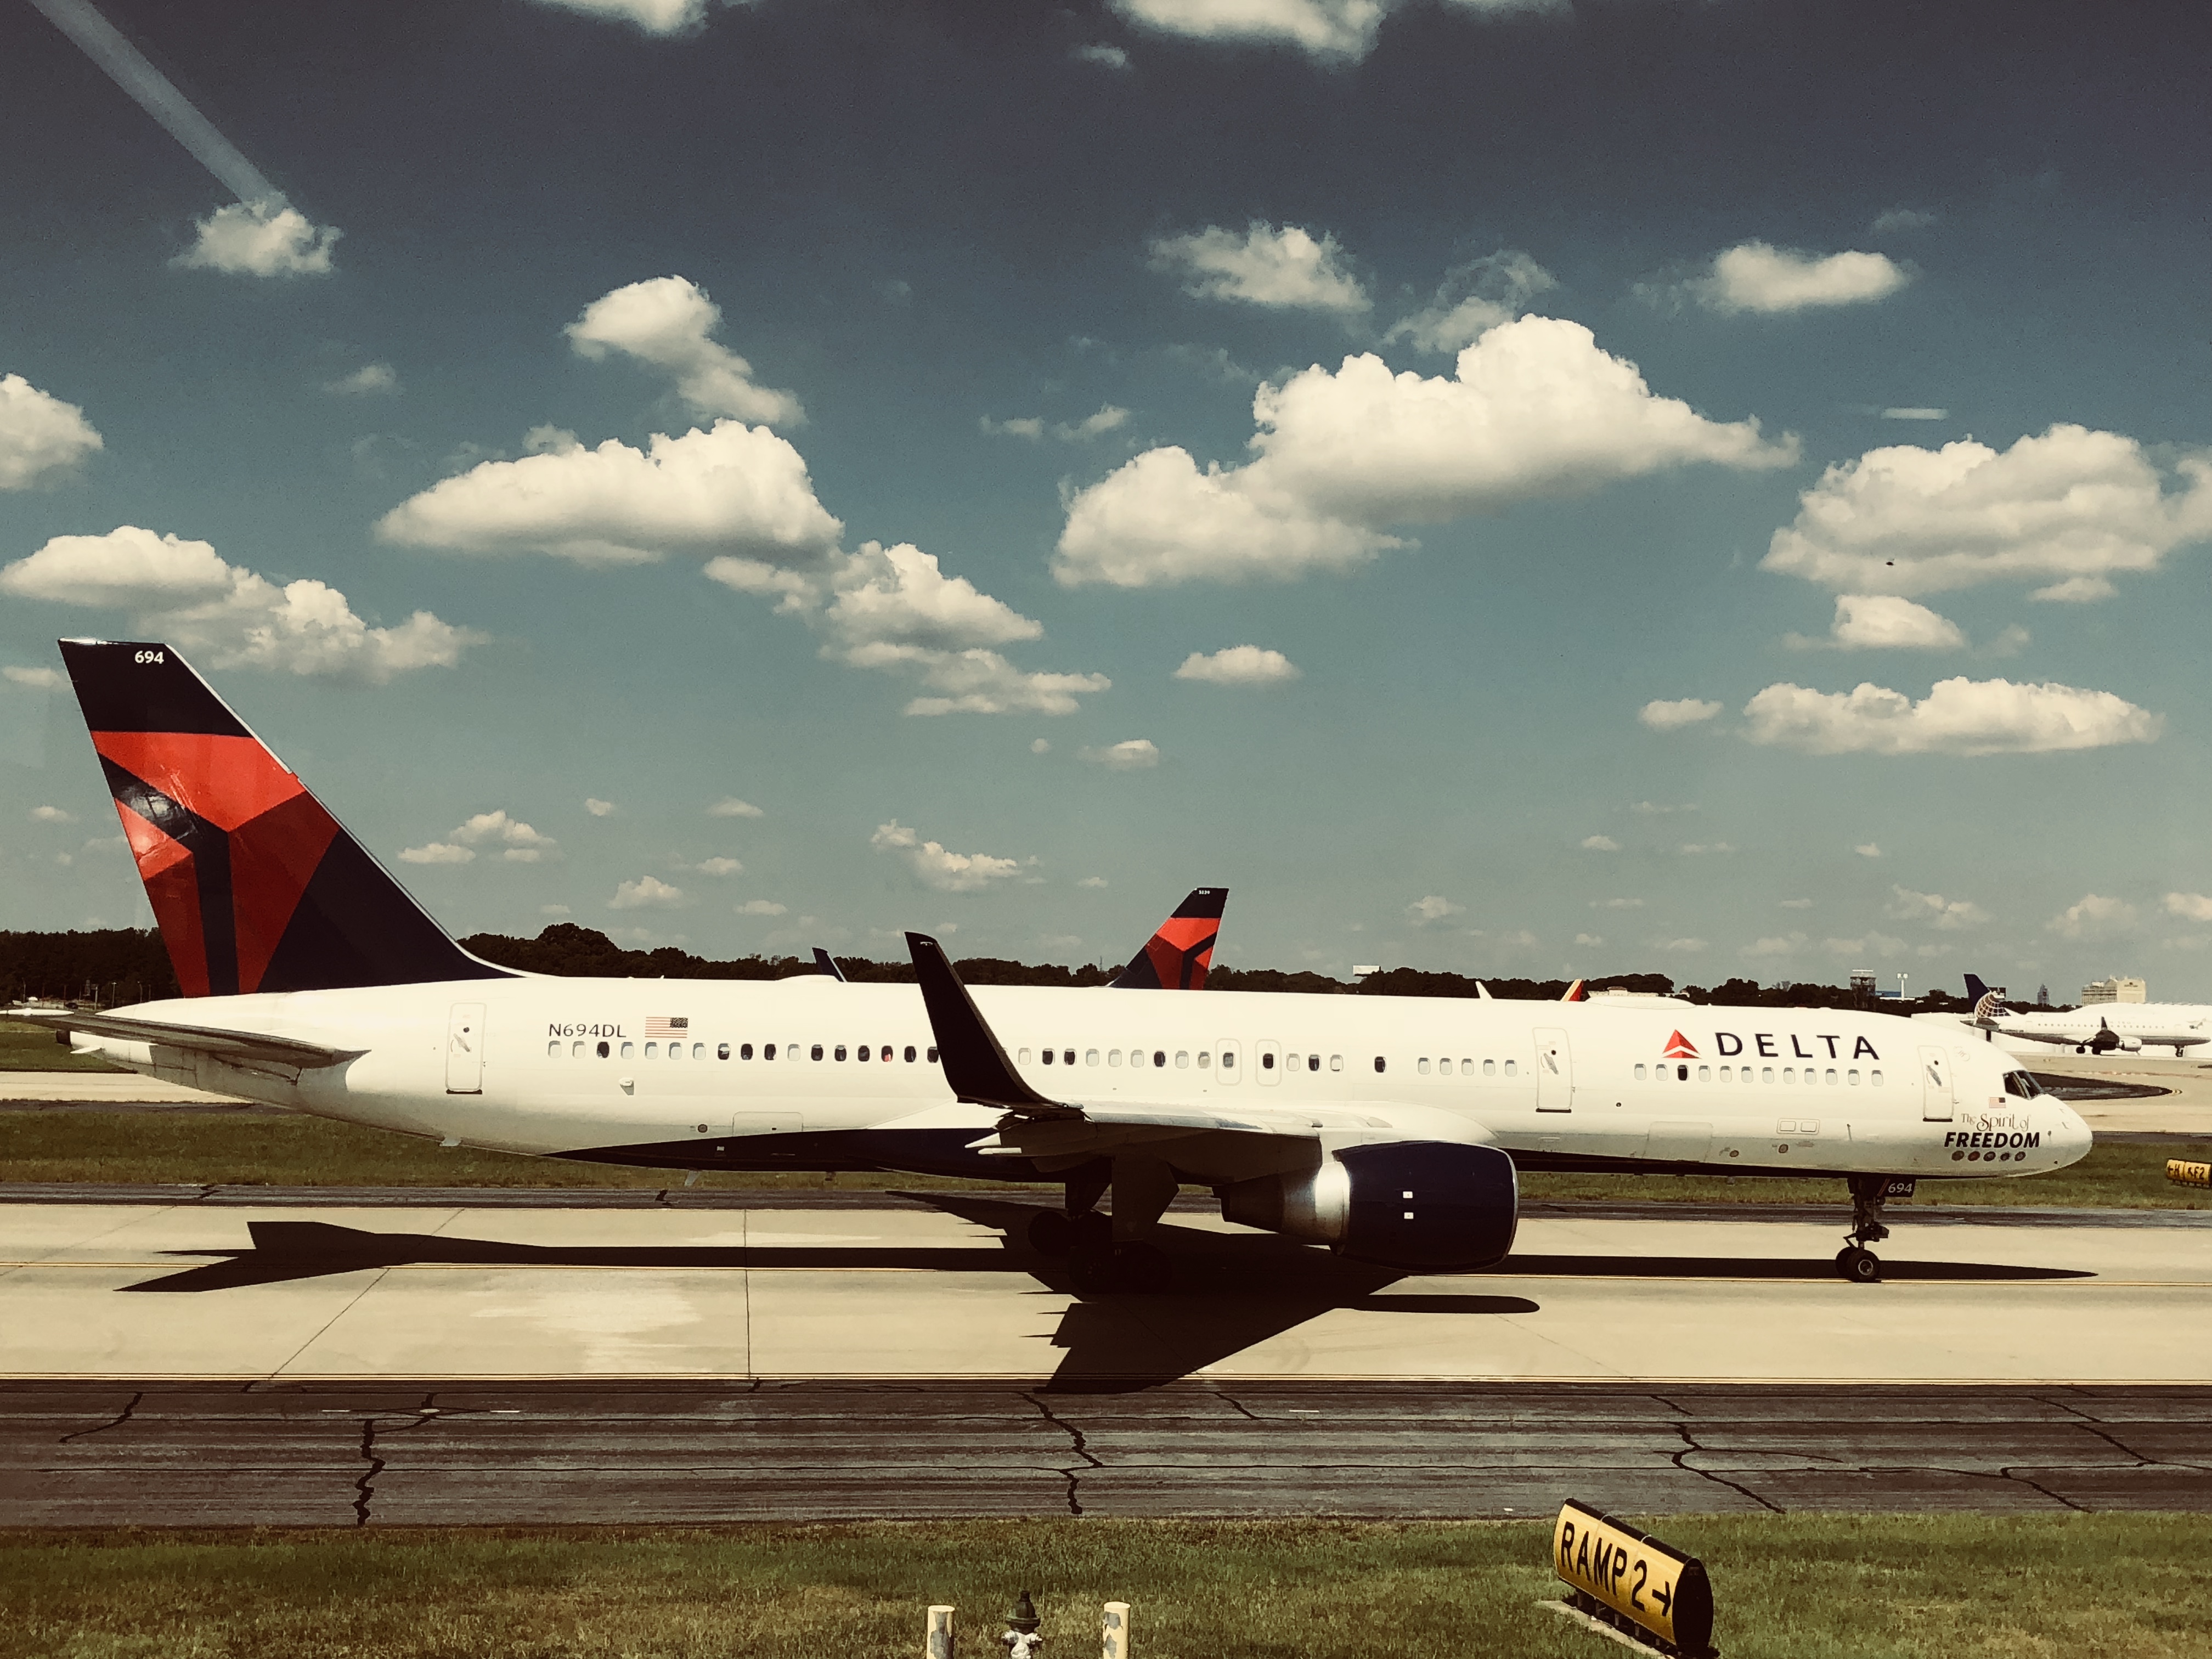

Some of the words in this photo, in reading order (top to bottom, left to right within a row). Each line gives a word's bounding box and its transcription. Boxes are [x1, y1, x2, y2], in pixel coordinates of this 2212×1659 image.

[134, 651, 164, 664] 694
[549, 1023, 627, 1038] N694DL
[1715, 1032, 1880, 1060] DELTA
[1961, 1113, 1976, 1125] The
[1976, 1112, 2019, 1132] Spirit
[2019, 1114, 2031, 1132] of
[1944, 1132, 2040, 1148] FREEDOM
[1888, 1183, 1912, 1193] 694
[1561, 1521, 1627, 1596] RAMP
[1632, 1560, 1647, 1612] 2
